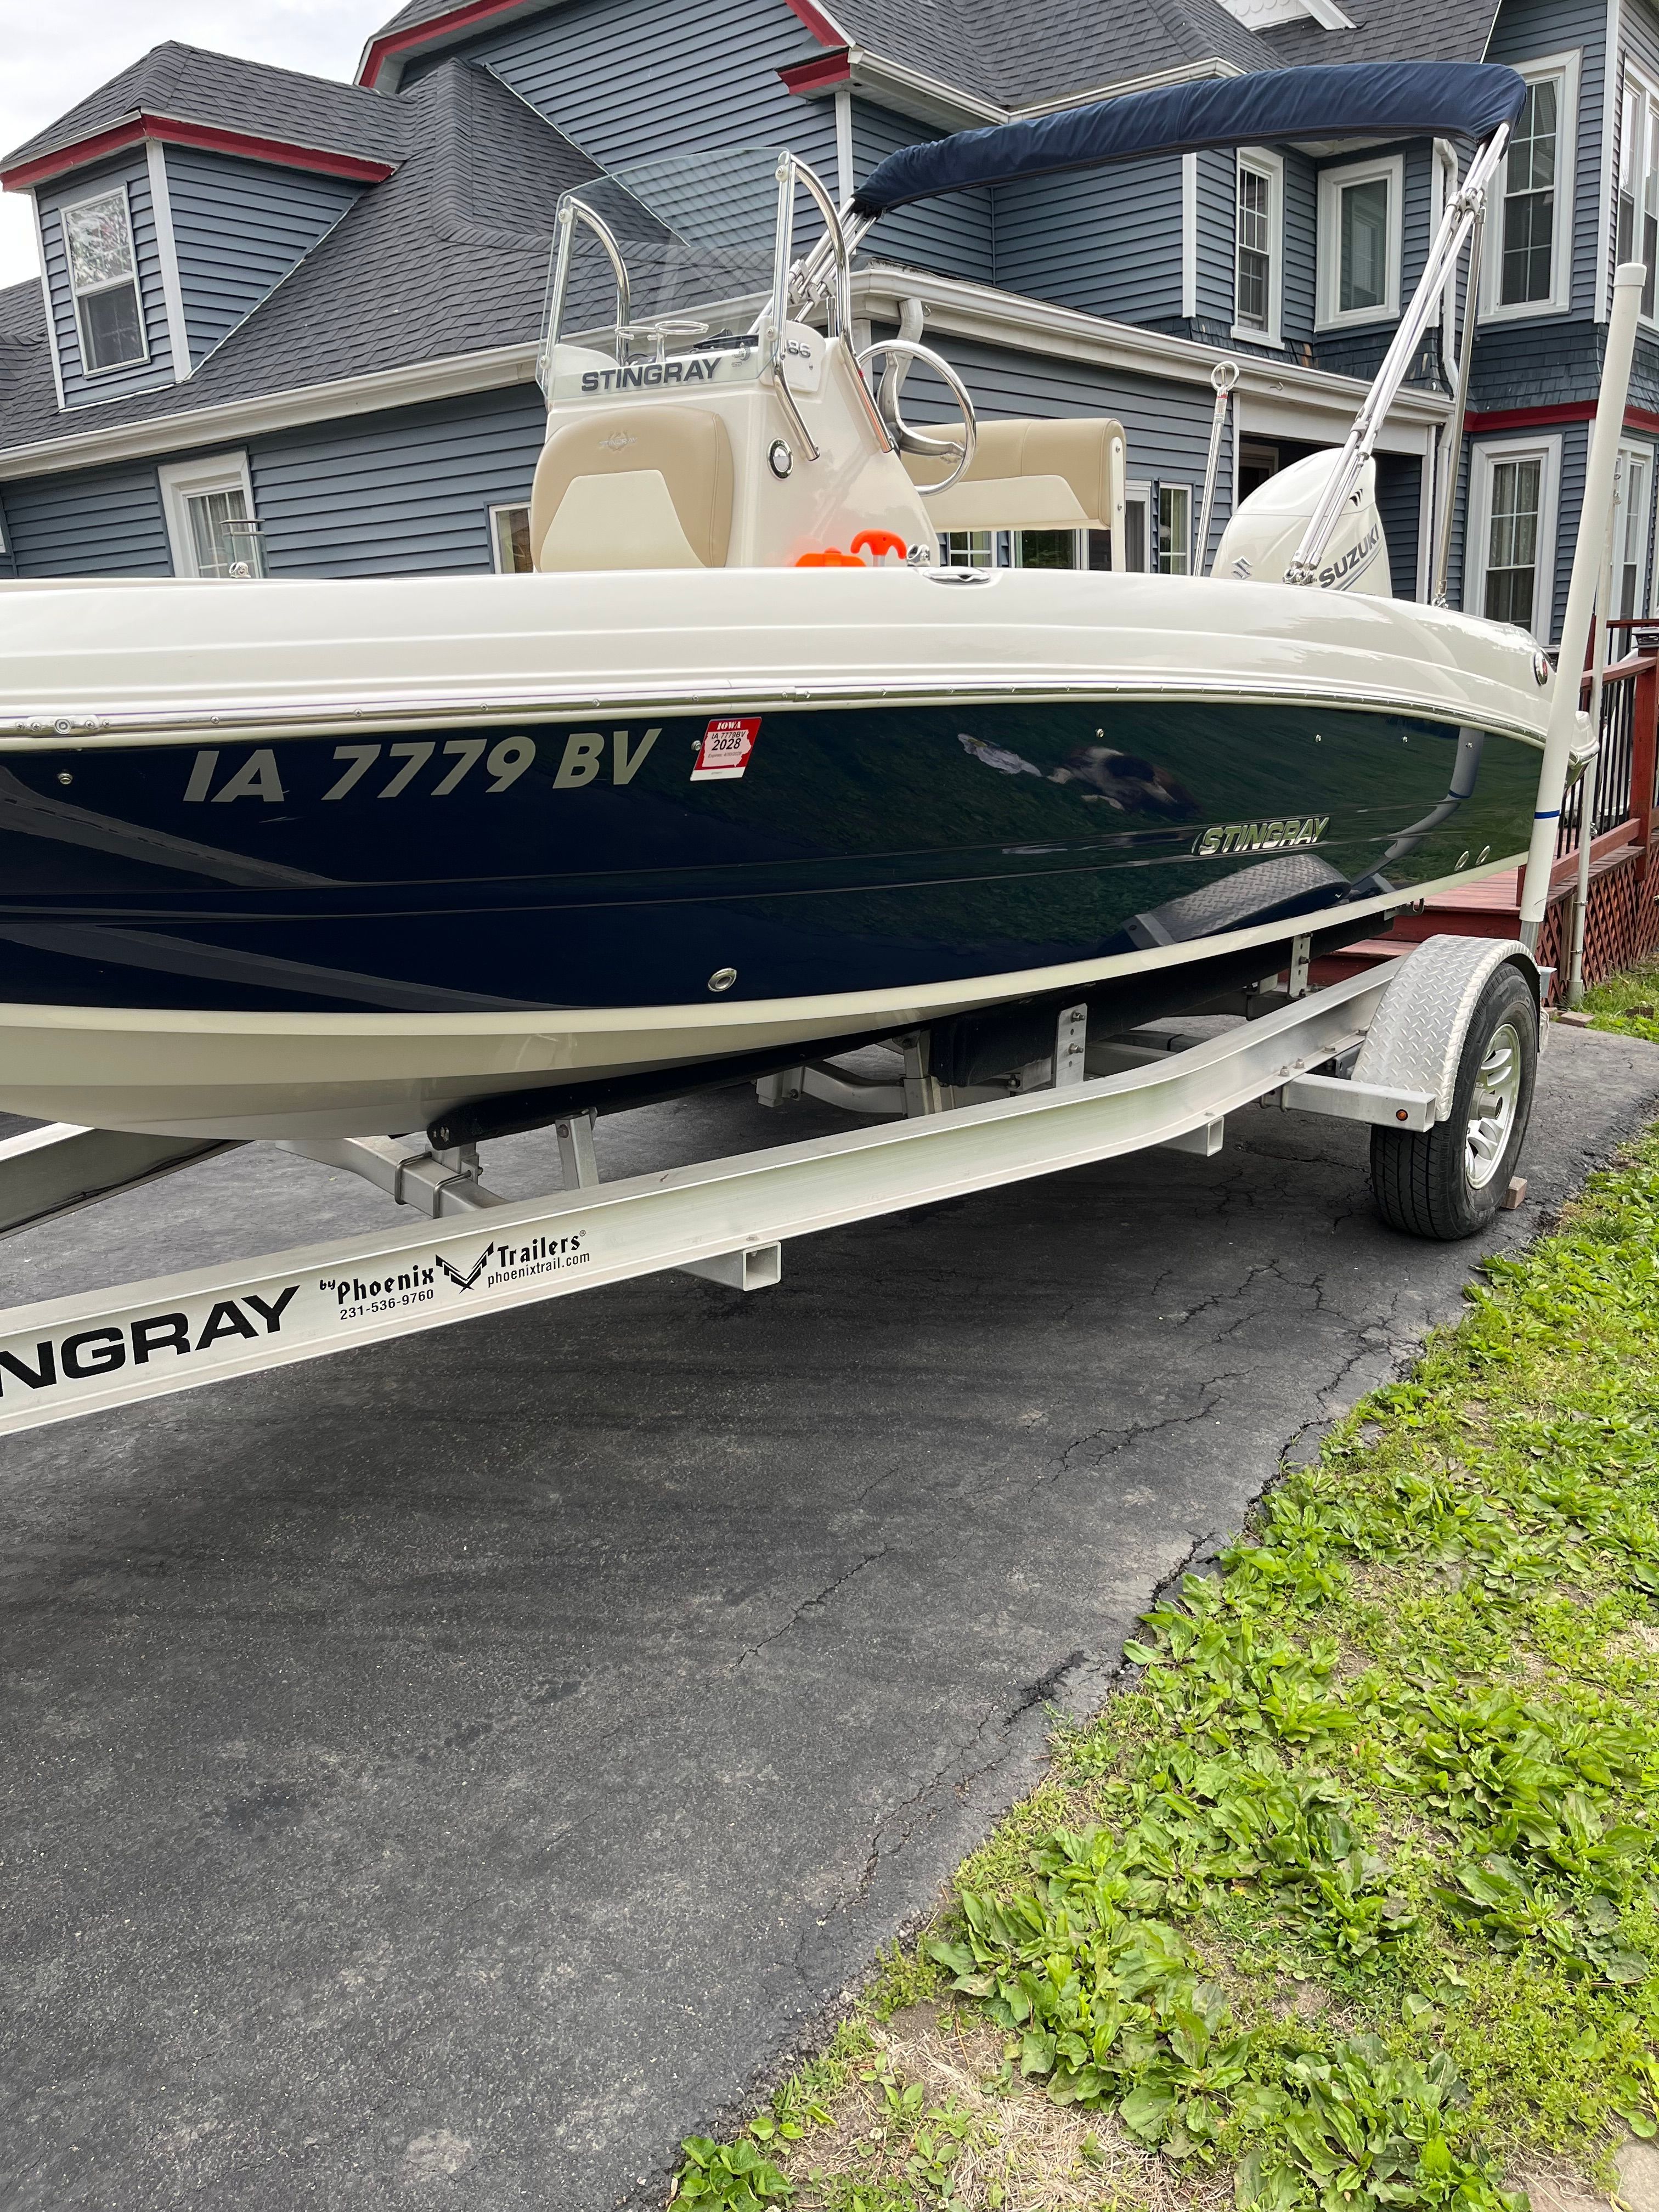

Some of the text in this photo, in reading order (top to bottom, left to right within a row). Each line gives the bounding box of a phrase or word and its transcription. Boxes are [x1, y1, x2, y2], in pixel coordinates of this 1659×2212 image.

[785, 339, 811, 358] 86
[582, 357, 721, 392] STINGRAY
[1319, 523, 1379, 588] SUZUKI
[716, 721, 741, 730] IOWA
[720, 731, 747, 739] 7779BV
[711, 738, 741, 751] 2028
[183, 728, 662, 802] IA 7779 BV
[1199, 817, 1329, 855] STINGRAY
[319, 1279, 336, 1291] by
[337, 1265, 435, 1305] Phoenix
[488, 1252, 590, 1288] phoenixtrail.com
[340, 1289, 434, 1320] 231-536-9760
